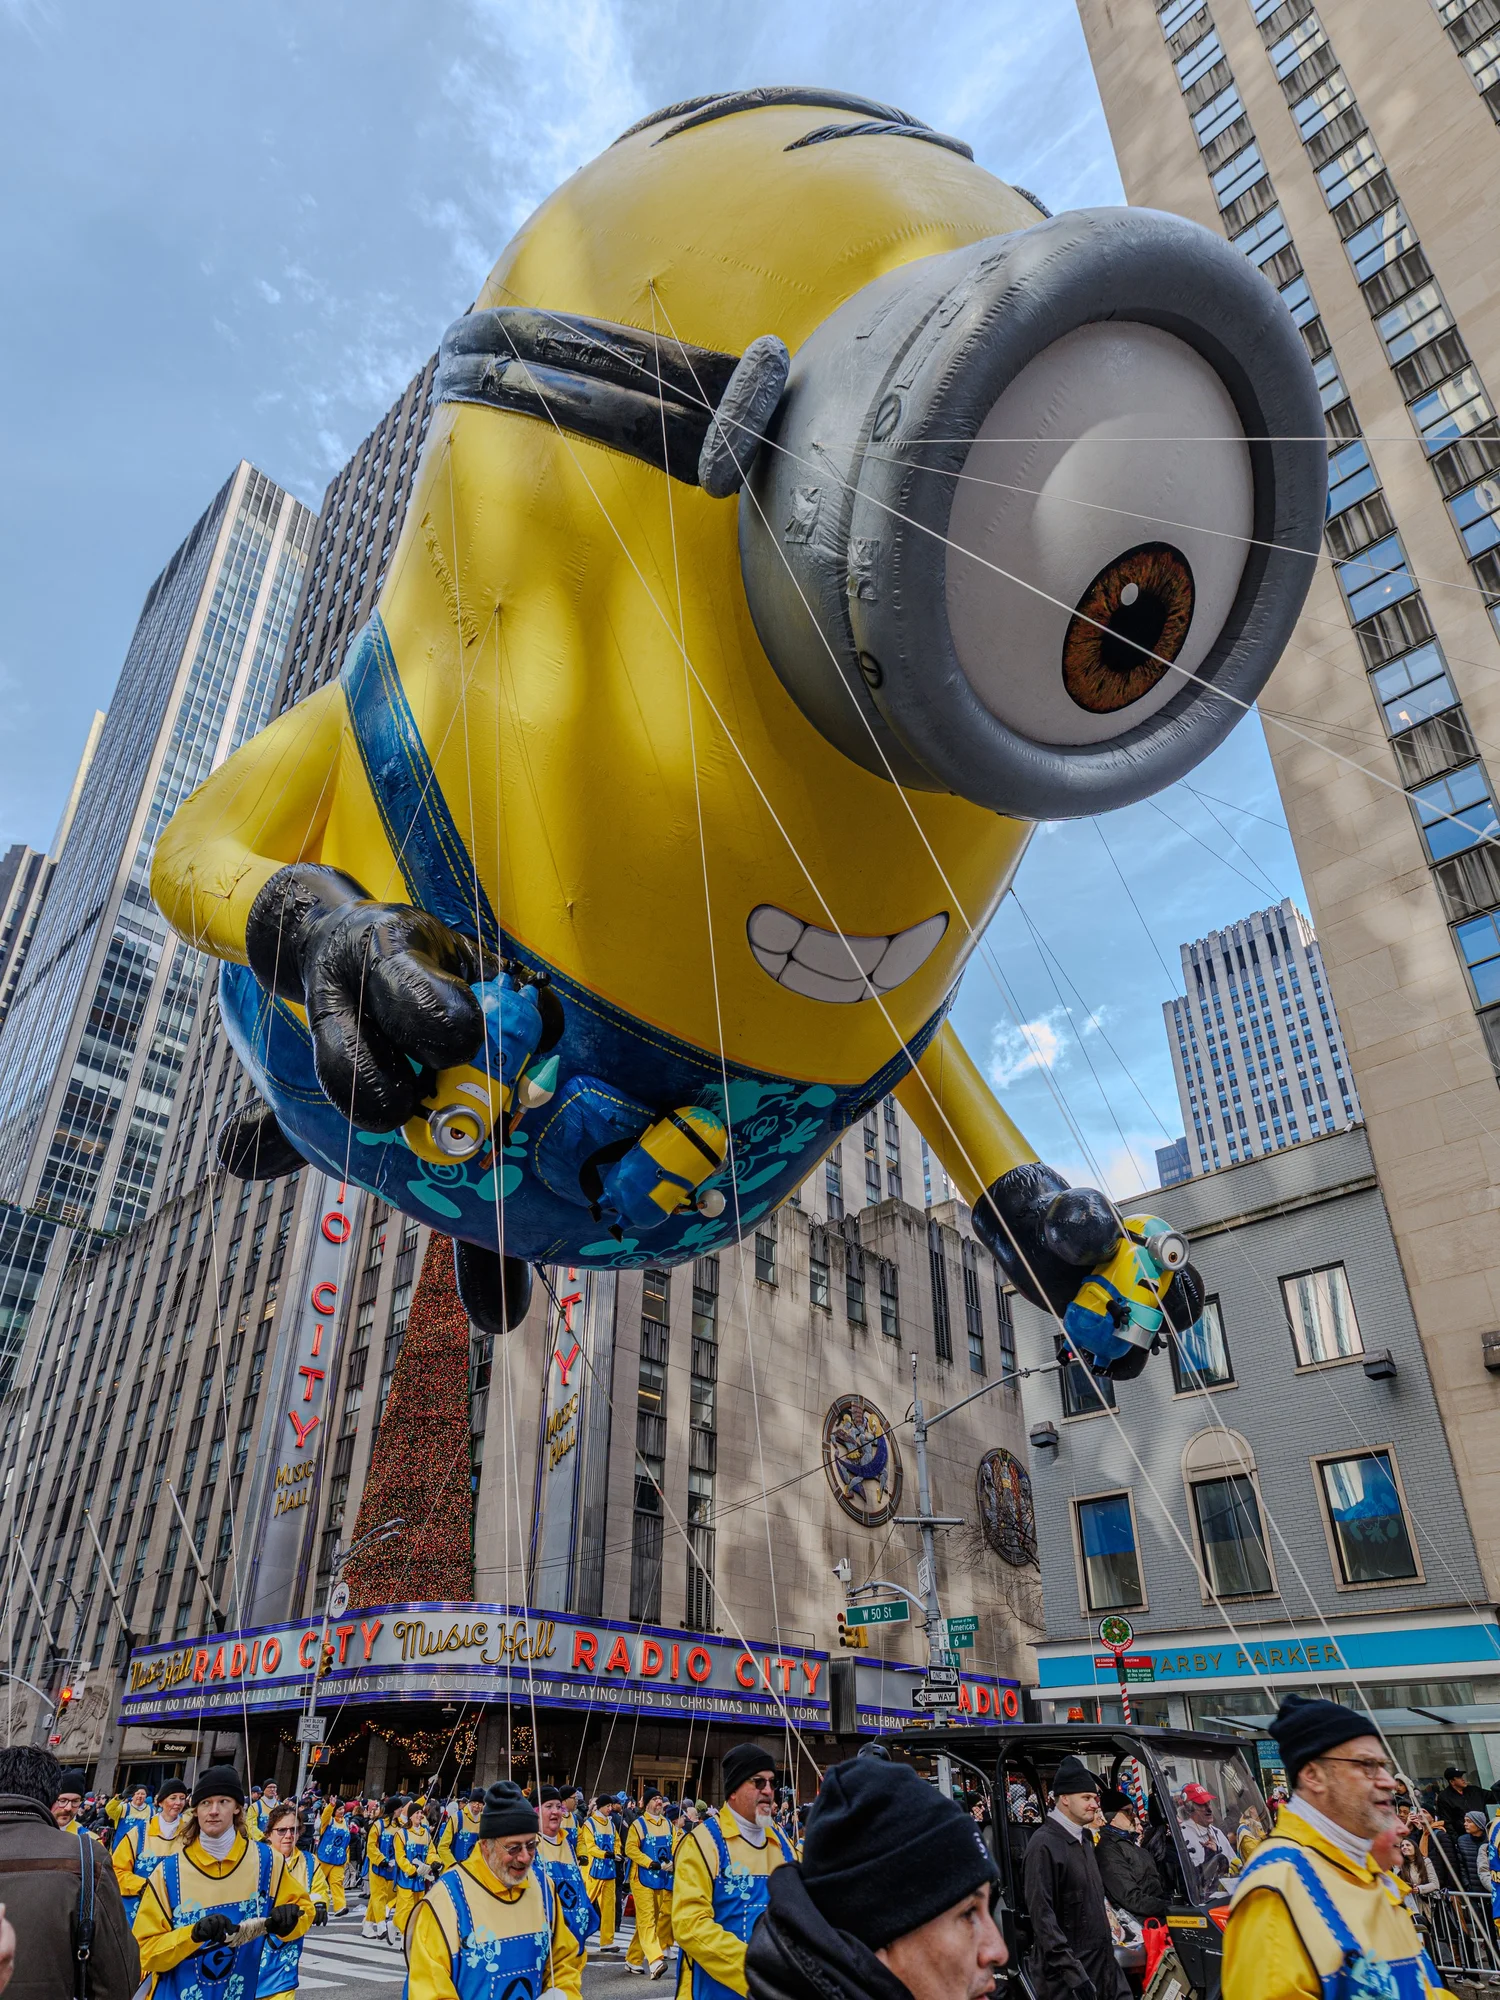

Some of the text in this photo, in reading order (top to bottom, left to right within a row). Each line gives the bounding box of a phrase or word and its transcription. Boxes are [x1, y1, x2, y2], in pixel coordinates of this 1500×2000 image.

[288, 1282, 339, 1449] CITY
[546, 1393, 578, 1443] MUSIC
[549, 1426, 576, 1472] HALL
[273, 1460, 313, 1492] MUSIC
[274, 1487, 308, 1518] HALL
[862, 1606, 892, 1621] W 50 St
[950, 1622, 976, 1632] Americas
[954, 1635, 960, 1647] 6
[1236, 1644, 1341, 1668] PARKER
[157, 1645, 195, 1692] Hall
[192, 1636, 282, 1682] RADIO
[393, 1620, 823, 1695] Music Hall RADIO CITY
[932, 1671, 956, 1681] ONE WAY
[125, 1701, 161, 1716] CELEBRATE
[165, 1698, 180, 1711] 100
[183, 1695, 206, 1709] YEARS
[209, 1693, 221, 1707] OF
[224, 1688, 272, 1703] ROCKETTES
[276, 1686, 288, 1699] AT
[521, 1679, 819, 1720] NOW PLAYING THIS IS CHRISTMAS IN NEW YORK
[918, 1692, 953, 1702] ONE WAY
[957, 1683, 1019, 1718] ADIO
[164, 1743, 186, 1753] Subway
